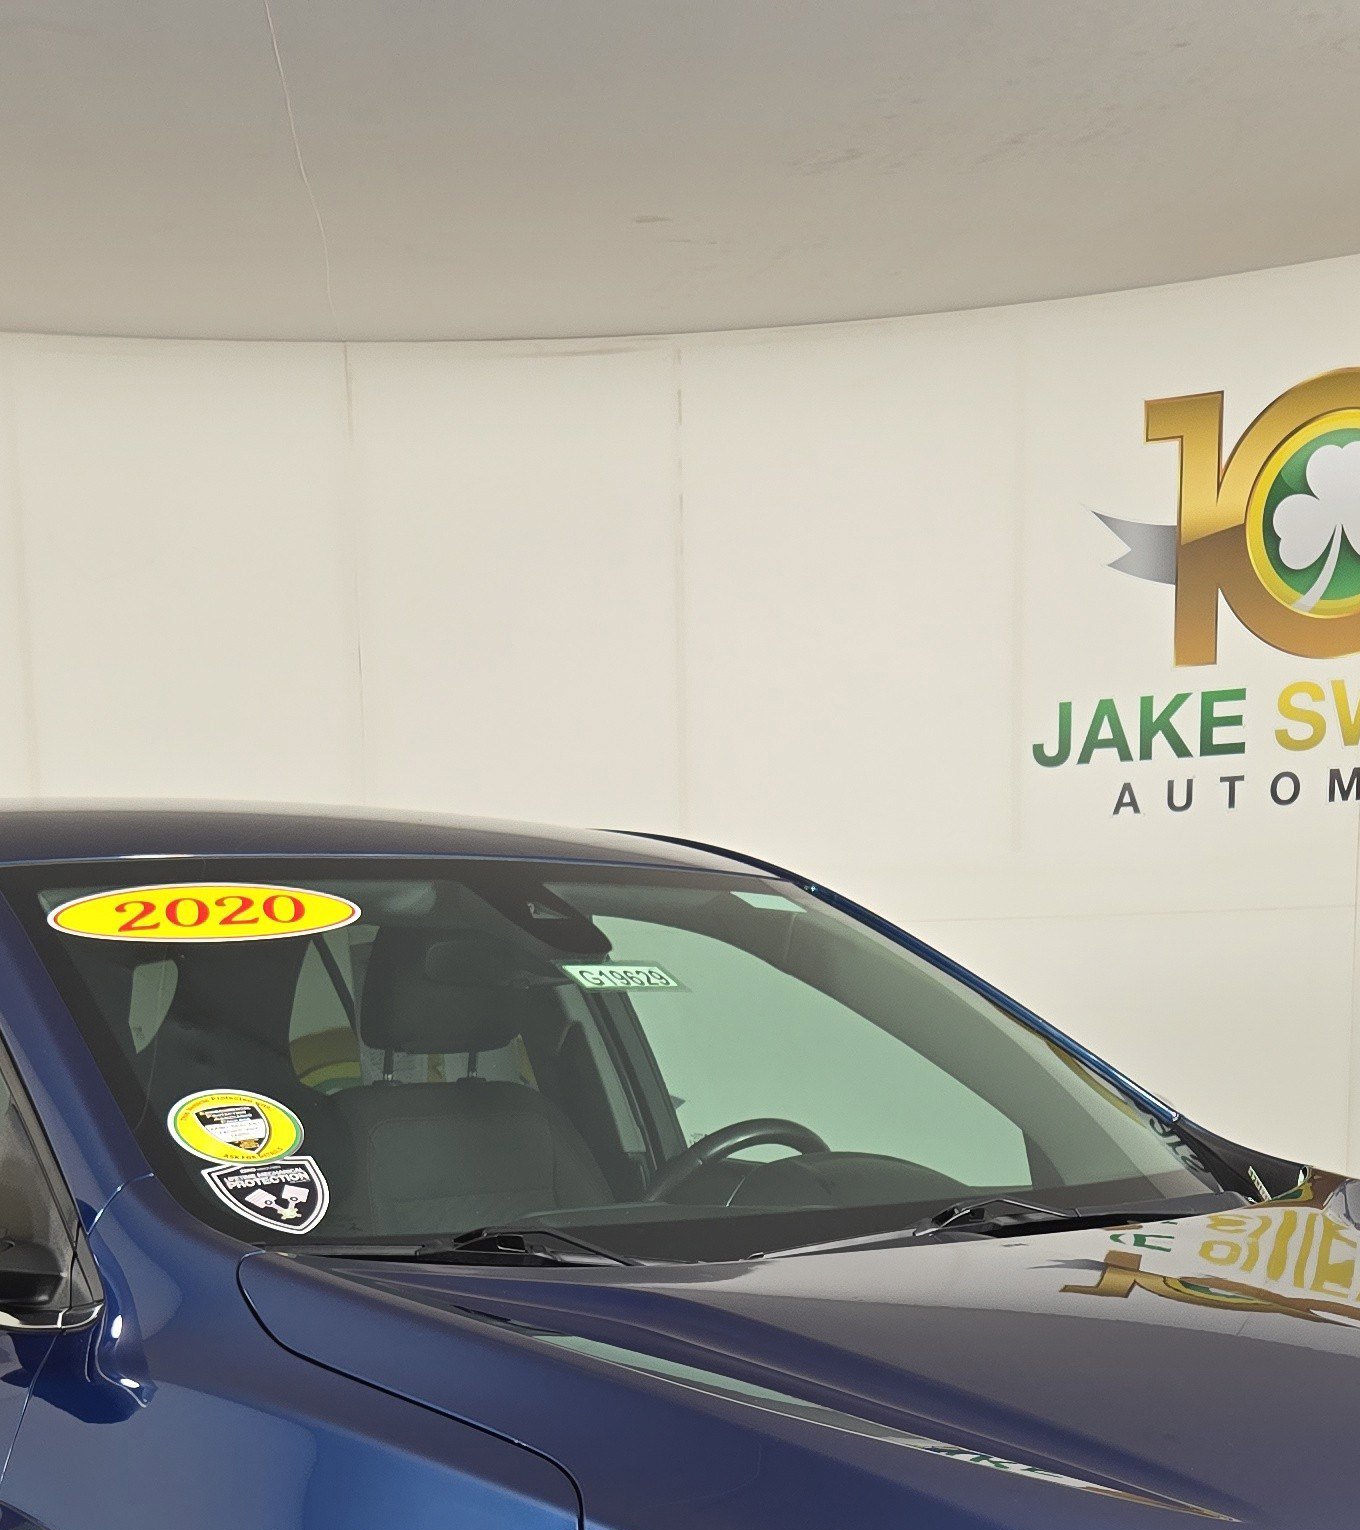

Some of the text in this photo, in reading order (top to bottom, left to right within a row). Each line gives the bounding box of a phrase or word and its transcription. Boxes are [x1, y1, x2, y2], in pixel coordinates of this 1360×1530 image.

[1032, 688, 1248, 767] JAKE
[114, 894, 306, 932] 2020
[579, 970, 671, 986] G19629
